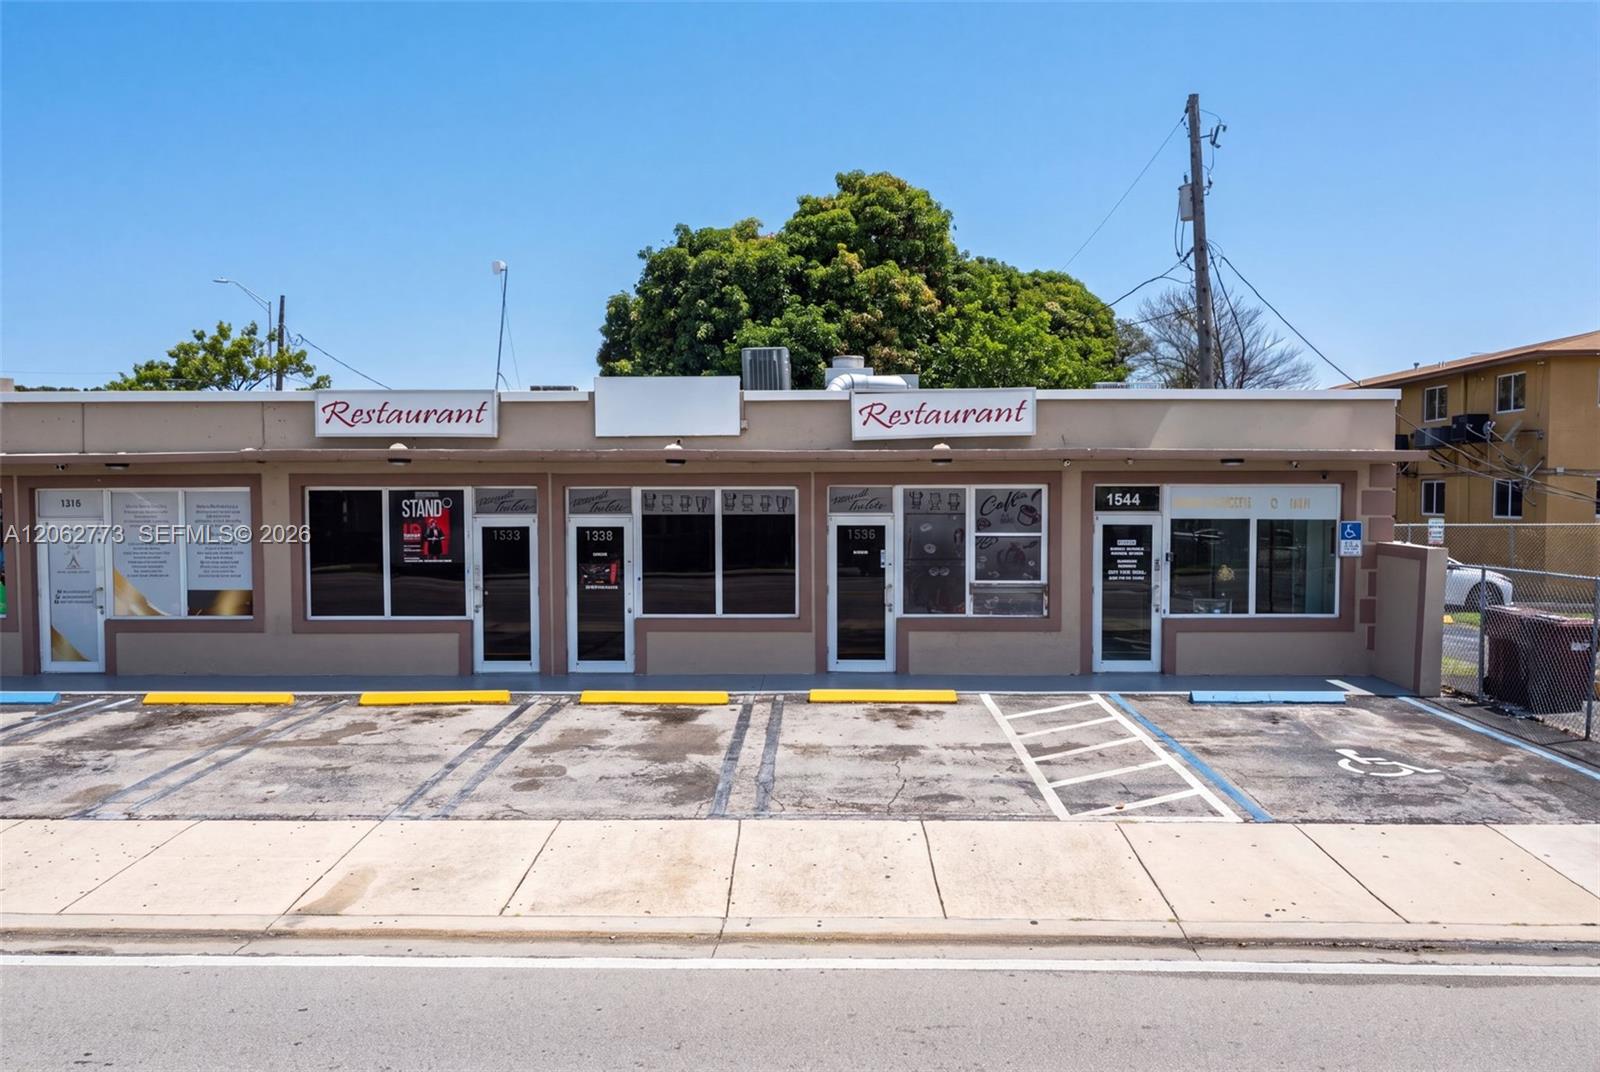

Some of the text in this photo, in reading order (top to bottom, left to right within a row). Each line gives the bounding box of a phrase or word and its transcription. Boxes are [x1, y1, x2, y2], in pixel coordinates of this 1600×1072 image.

[322, 400, 488, 428] Restaurant
[858, 399, 1028, 429] Restaurant
[1106, 493, 1140, 506] 1544
[402, 499, 442, 518] STAND
[493, 530, 521, 541] 1533
[585, 530, 613, 541] 1338
[848, 529, 876, 540] 1536
